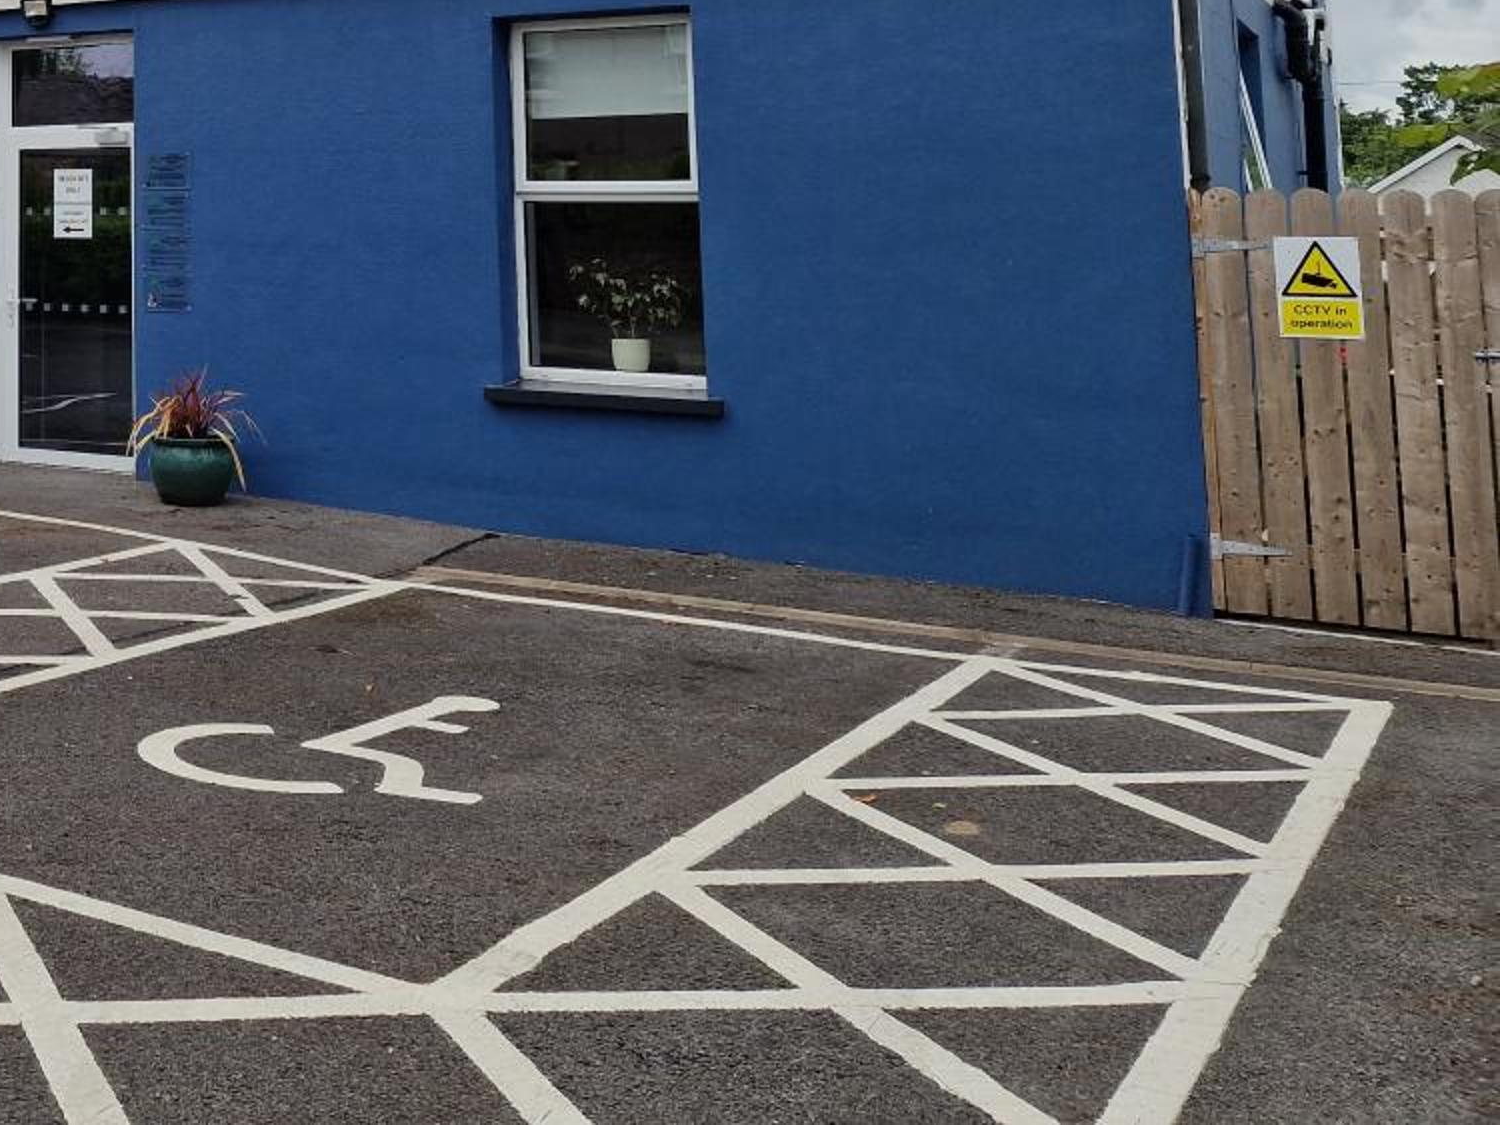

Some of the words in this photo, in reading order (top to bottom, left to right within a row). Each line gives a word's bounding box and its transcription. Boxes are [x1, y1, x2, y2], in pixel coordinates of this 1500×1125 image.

[1293, 304, 1331, 316] CCTV
[1335, 305, 1348, 316] in
[1291, 318, 1353, 331] operation
